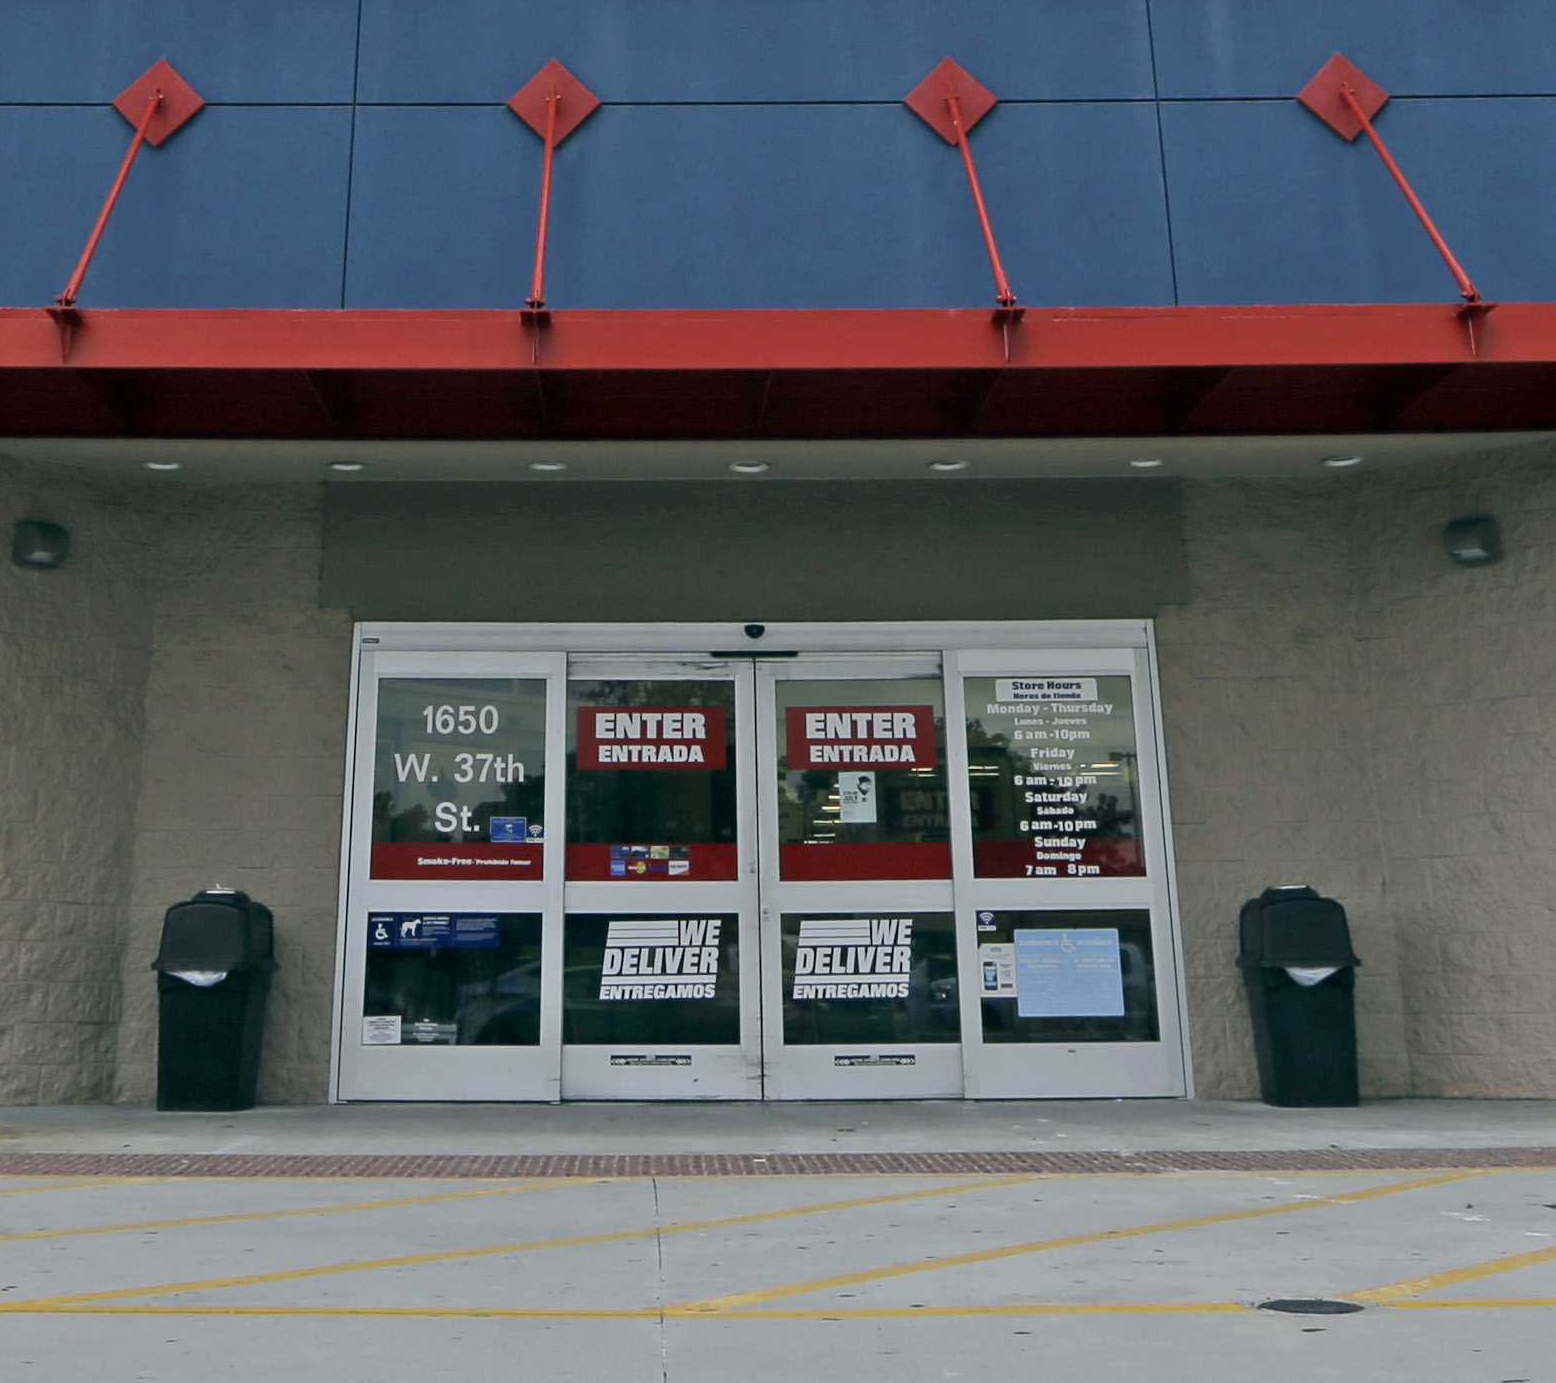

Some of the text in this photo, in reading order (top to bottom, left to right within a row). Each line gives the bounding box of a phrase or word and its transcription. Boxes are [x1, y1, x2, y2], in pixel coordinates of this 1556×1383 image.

[1012, 680, 1082, 690] Store Hours
[987, 704, 1040, 716] Monday
[1051, 702, 1114, 715] Thursday
[422, 705, 499, 734] 1650
[595, 713, 706, 739] ENTER
[805, 713, 917, 739] ENTER
[1051, 717, 1087, 725] Jueves
[598, 745, 704, 763] ENTRADA
[809, 745, 916, 763] ENTRADA
[1030, 747, 1075, 760] Friday
[394, 752, 525, 783] W. 37th
[1032, 762, 1072, 771] Viernes
[1025, 791, 1087, 804] Saturday
[434, 801, 480, 833] St.
[1034, 836, 1086, 850] Sunday
[1036, 851, 1082, 861] Domingo
[679, 920, 721, 946] WE
[871, 919, 913, 945] WE
[602, 947, 719, 975] DELIVER
[795, 946, 912, 974] DELIVER
[599, 984, 716, 1000] ENTREGAMOS
[793, 983, 909, 999] ENTREGAMOS
